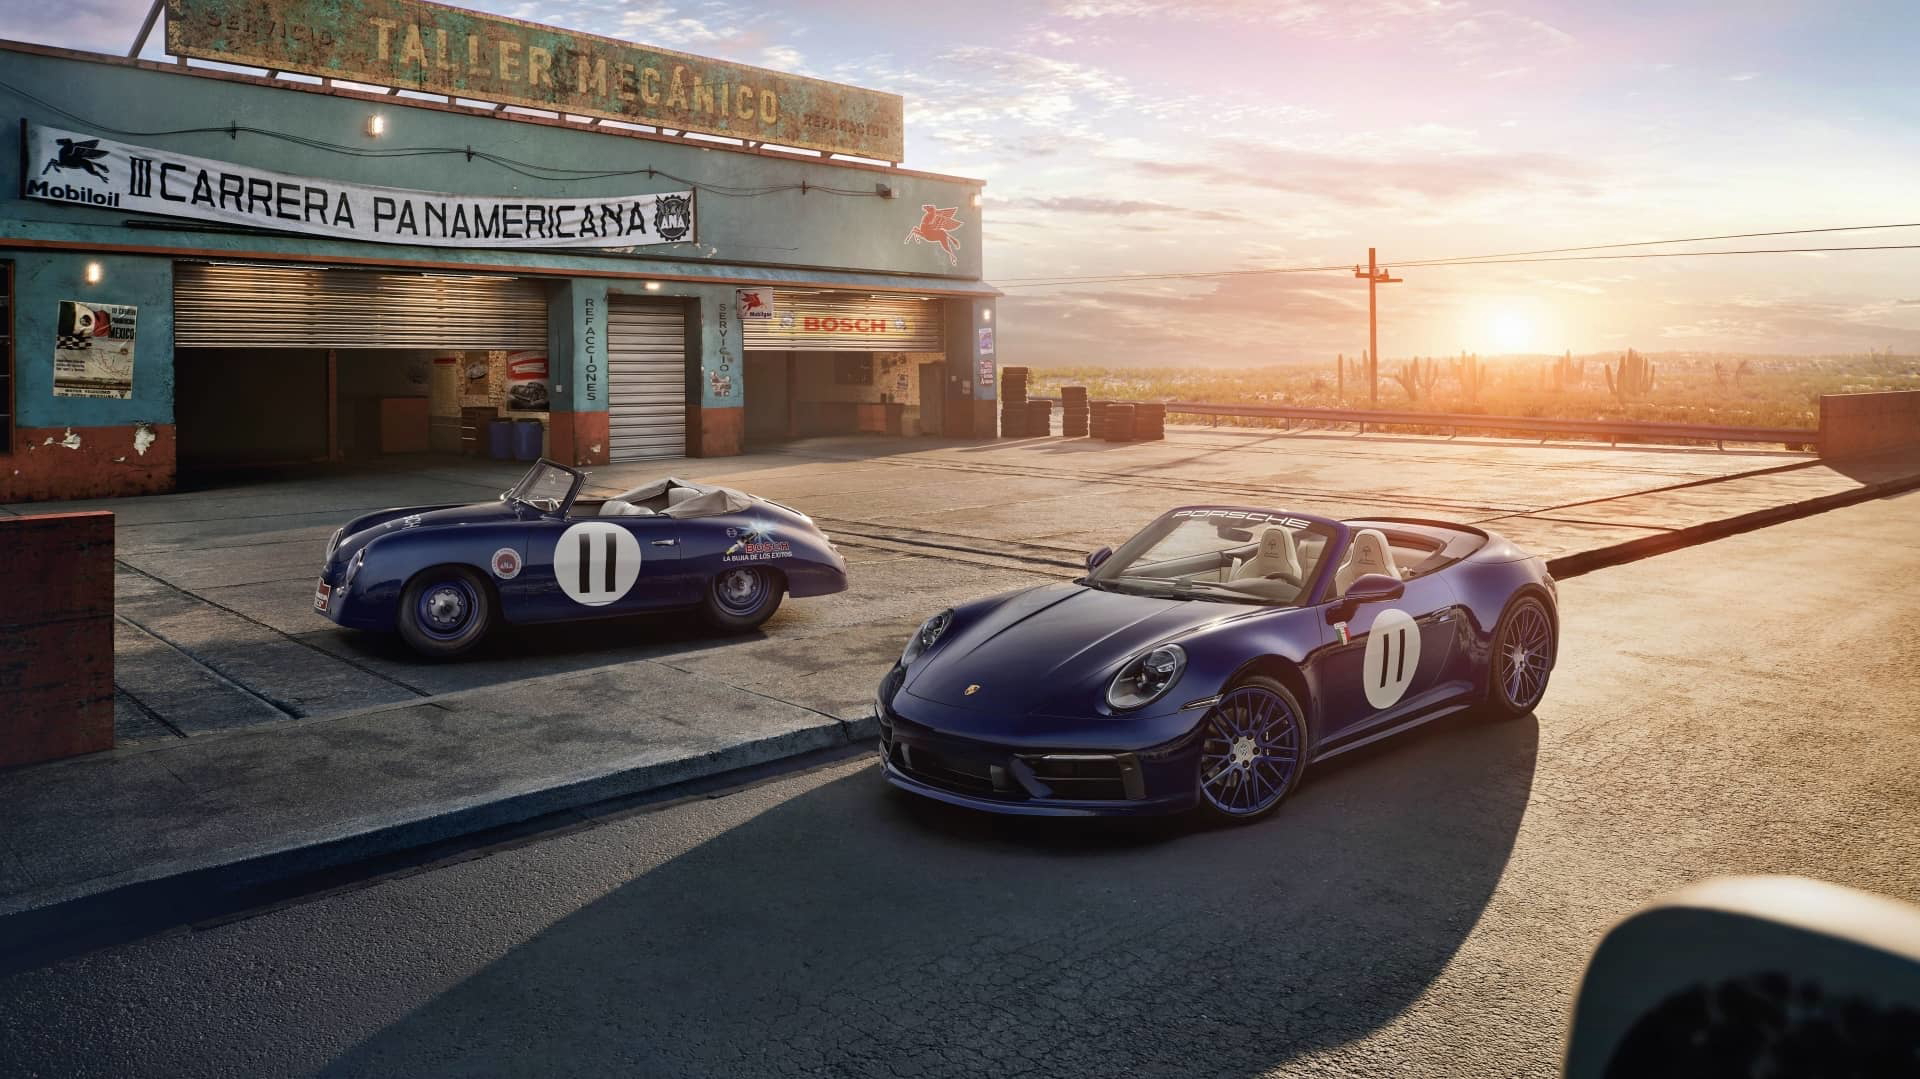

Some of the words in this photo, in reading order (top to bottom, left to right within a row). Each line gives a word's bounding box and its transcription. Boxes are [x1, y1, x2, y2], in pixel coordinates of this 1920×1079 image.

[369, 17, 553, 87] TALLER
[27, 179, 120, 208] Mobiloil
[129, 156, 152, 198] III
[160, 162, 355, 229] CARRERA
[373, 196, 647, 239] PANAMERICANA
[661, 214, 686, 229] ANA
[585, 299, 598, 401] REFACCIONES
[719, 304, 729, 372] SERVICIO
[803, 316, 887, 333] BOSCH
[745, 542, 790, 553] BOSCH
[1172, 510, 1312, 529] PORSCHE
[579, 532, 617, 594] 11
[1380, 629, 1406, 689] 11
